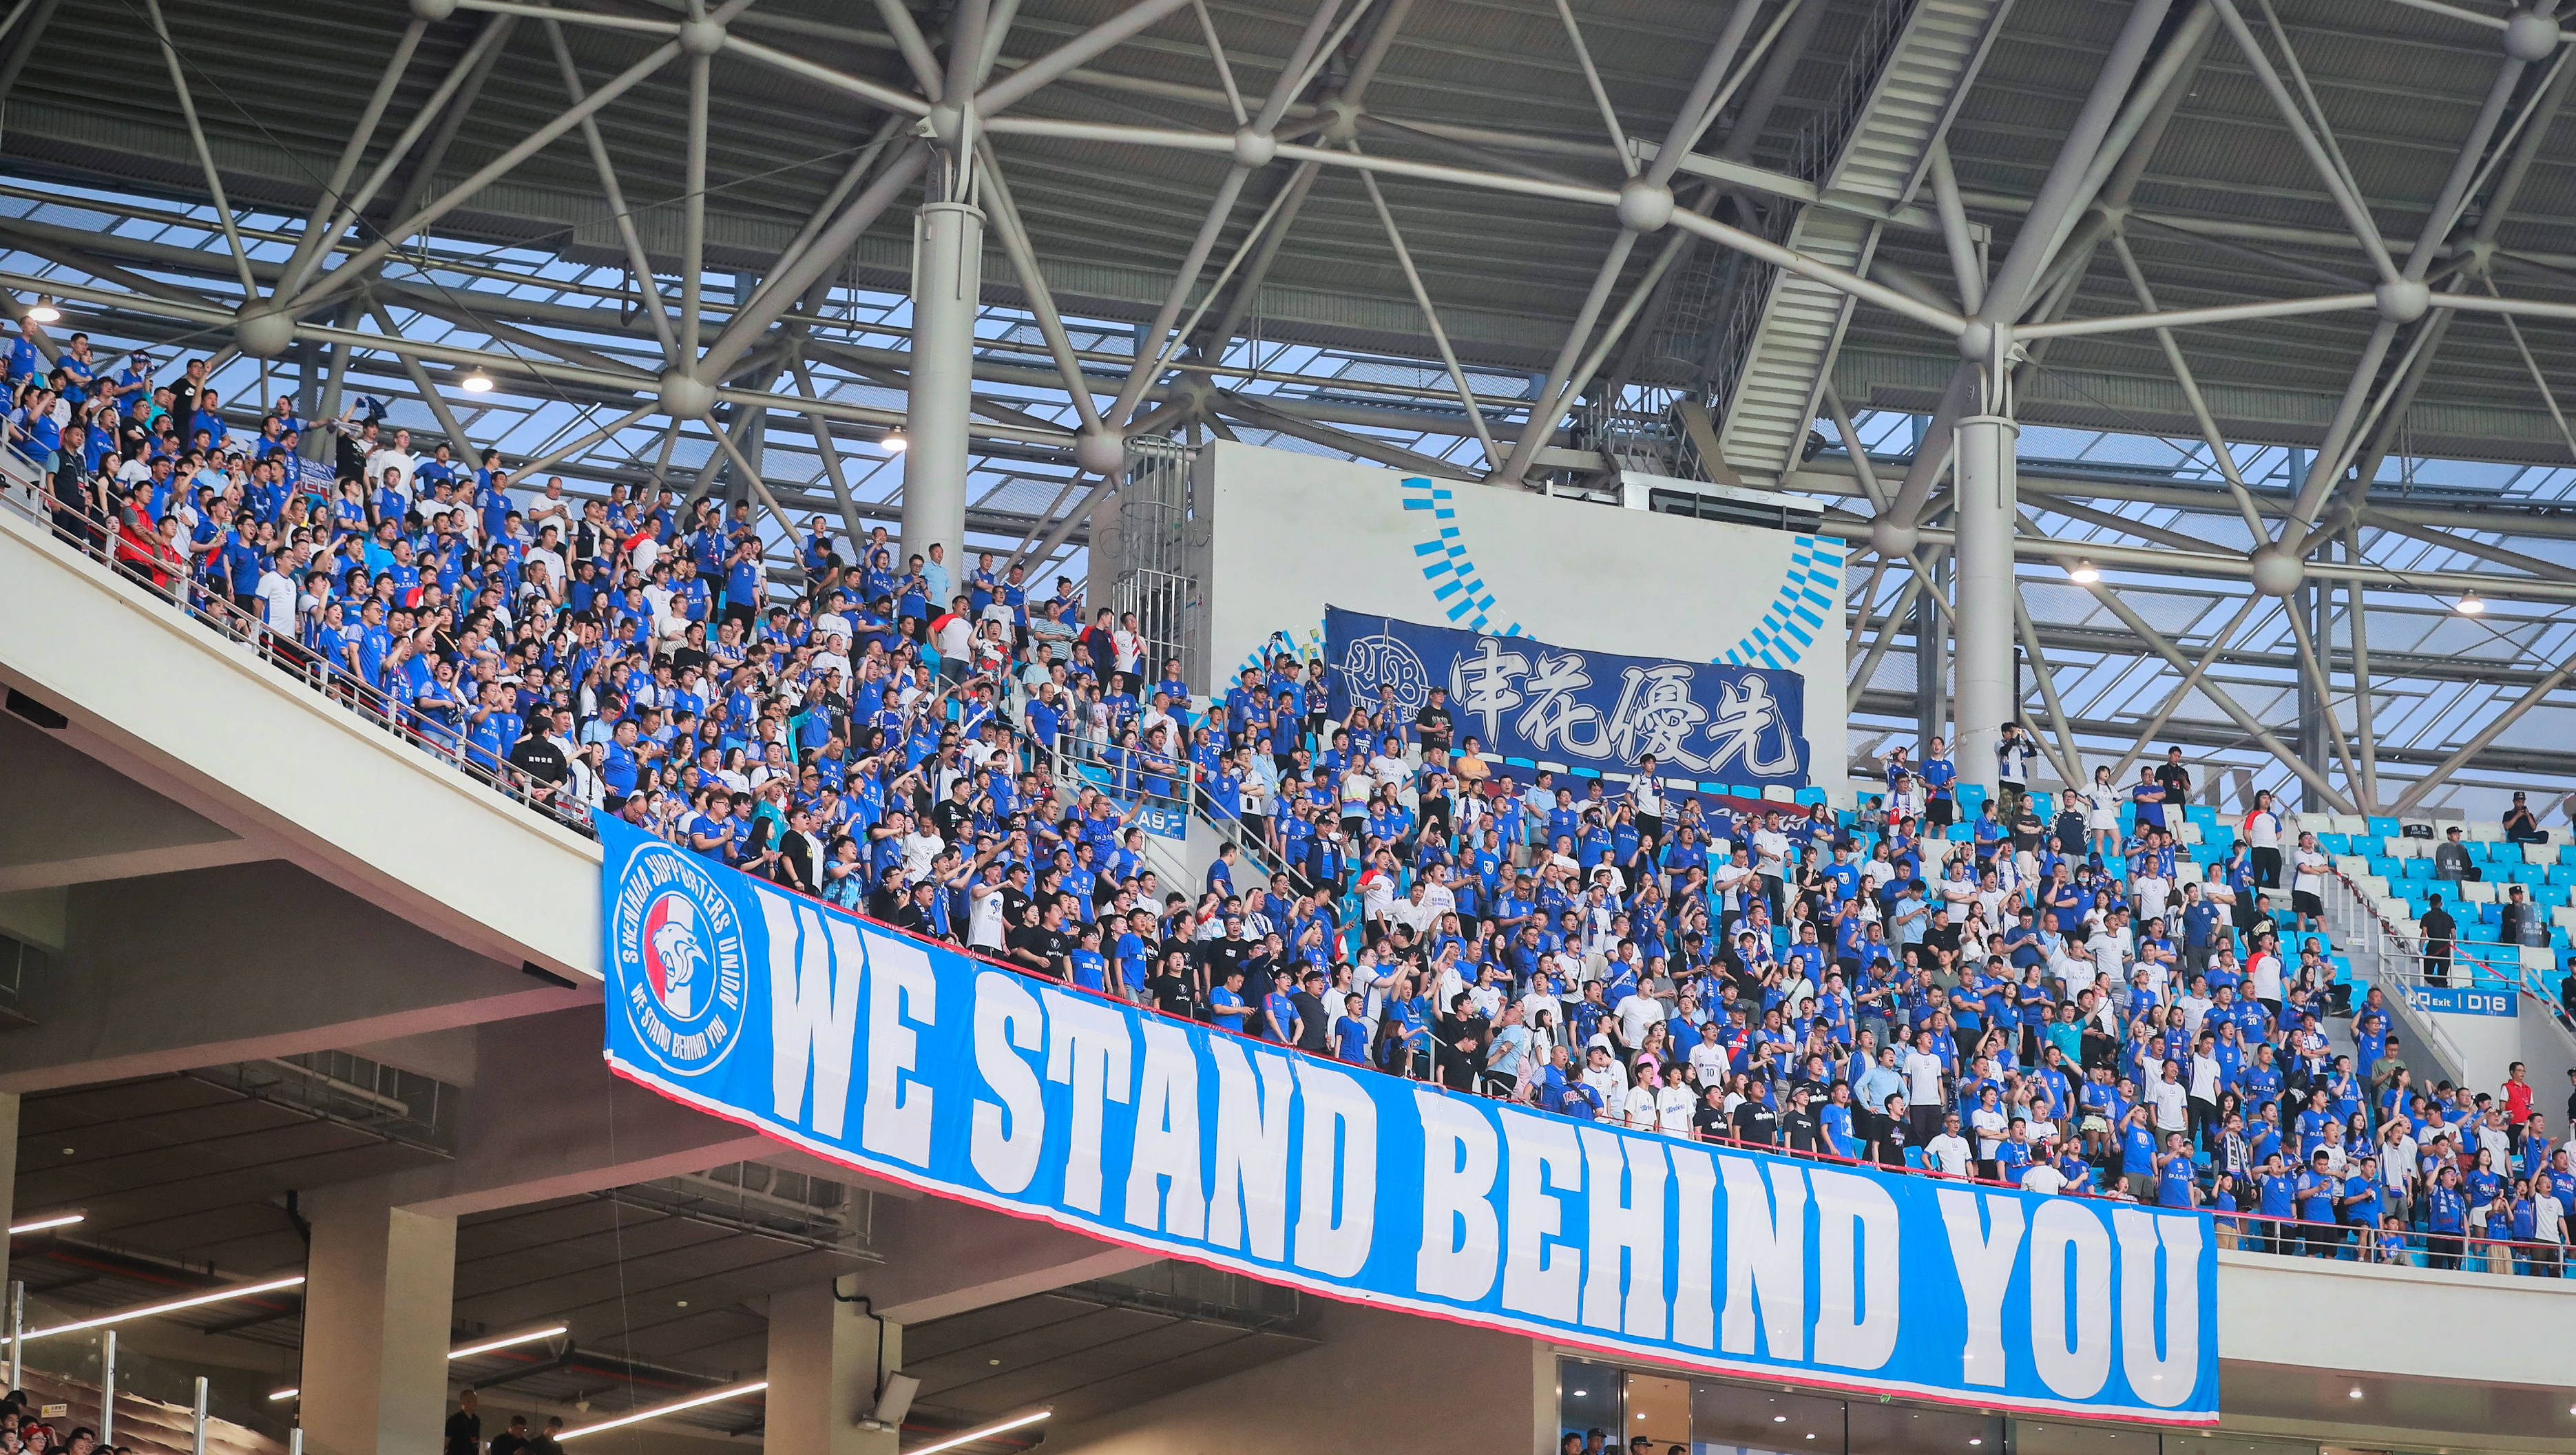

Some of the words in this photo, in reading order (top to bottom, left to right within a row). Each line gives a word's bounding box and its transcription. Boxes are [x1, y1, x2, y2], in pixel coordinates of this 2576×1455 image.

[1212, 746, 1221, 755] 22
[1359, 746, 1368, 754] 10
[622, 864, 653, 964] SHENHUA
[645, 853, 731, 934] SUPPORTERS
[718, 936, 740, 1011] UNION
[2432, 998, 2451, 1007] Exit
[2468, 994, 2506, 1012] D16
[630, 982, 648, 1015] WE
[640, 1008, 672, 1052] STAND
[672, 1032, 708, 1060] BEHIND
[704, 1014, 728, 1049] YOU
[1706, 1069, 1715, 1077] 10
[755, 886, 936, 1169] WE
[970, 971, 1376, 1278] STAND
[1412, 1089, 1899, 1371] BEHIND
[1936, 1188, 2203, 1407] YOU
